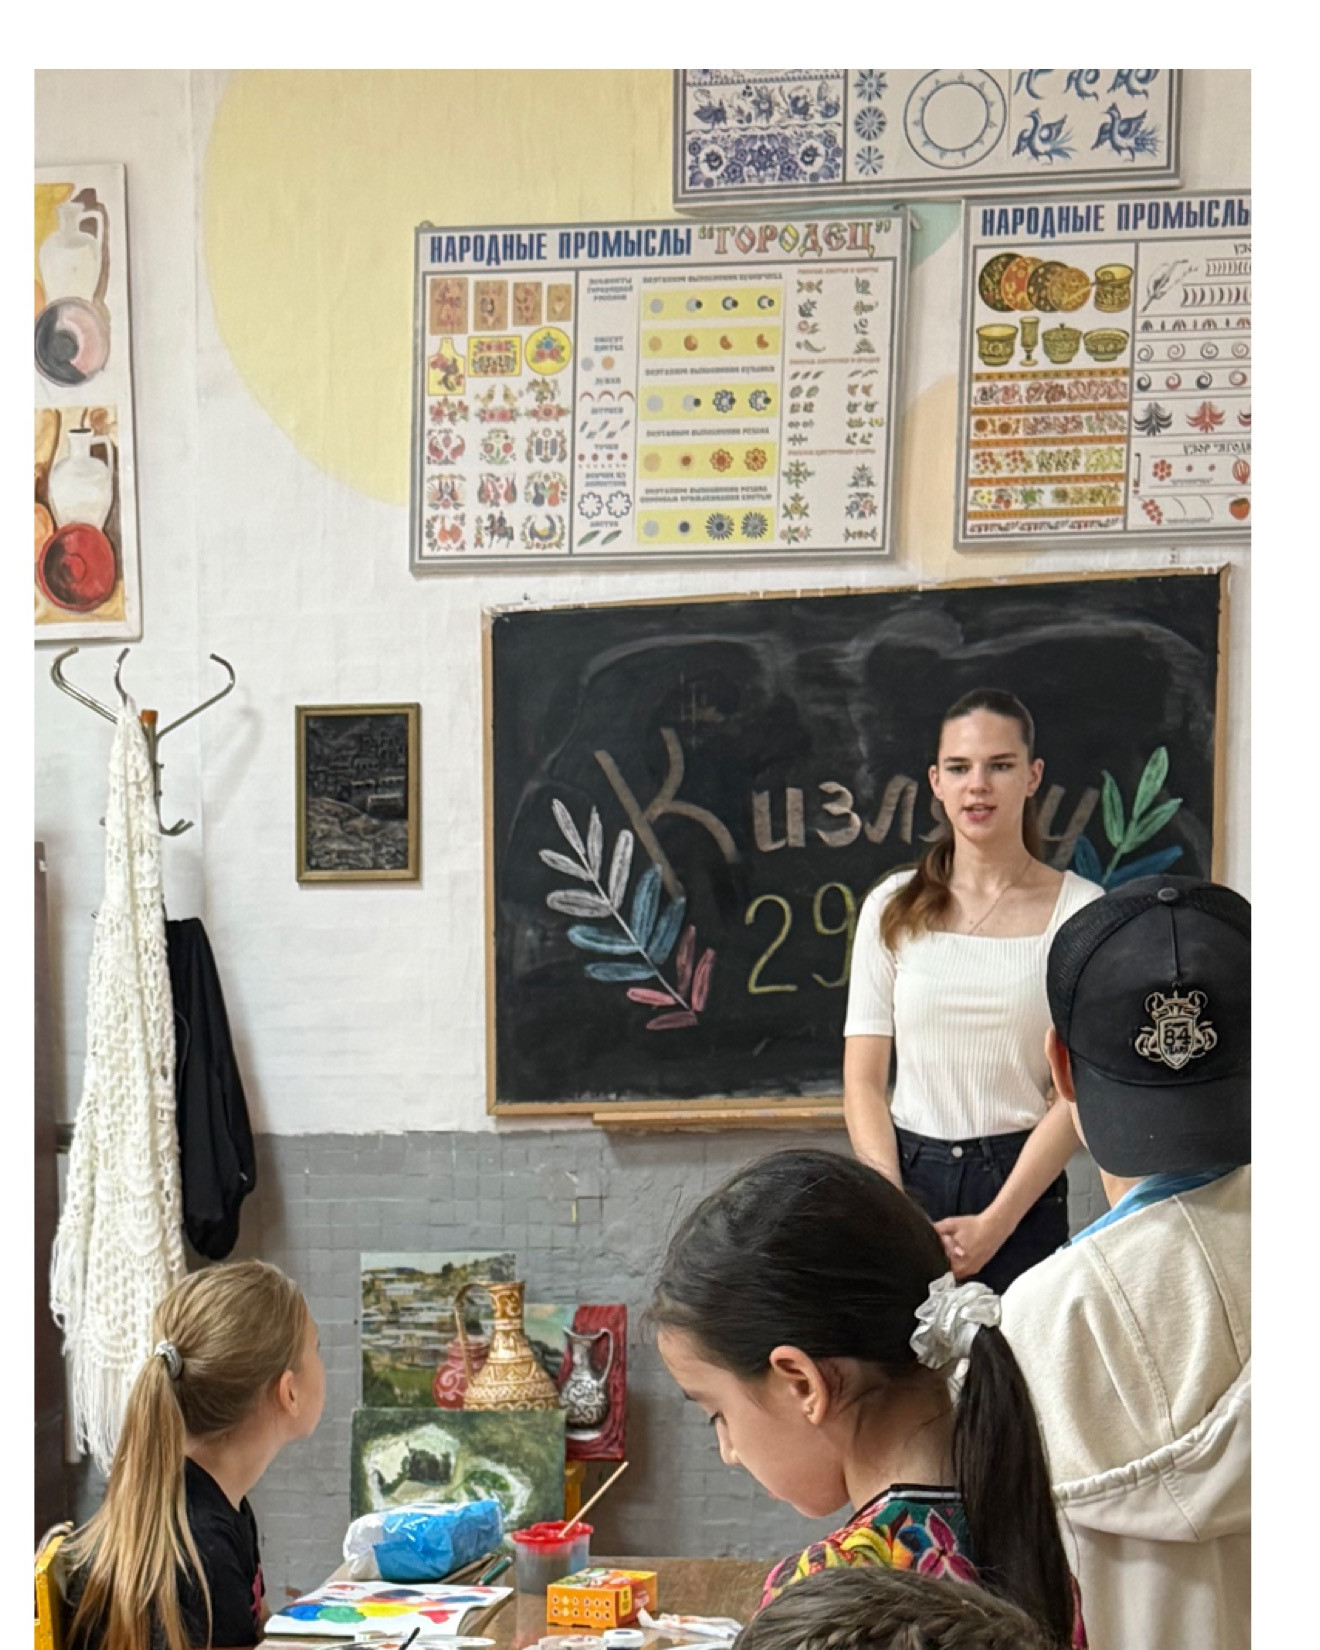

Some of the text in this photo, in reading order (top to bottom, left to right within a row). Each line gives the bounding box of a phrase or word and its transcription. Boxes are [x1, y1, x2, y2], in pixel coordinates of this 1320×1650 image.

[982, 204, 1105, 239] НАРОДНЫЕ
[430, 232, 547, 266] НАРОДНЫЕ
[559, 228, 692, 261] ПРОМЫСЛЫ
[1164, 1027, 1192, 1046] 84
